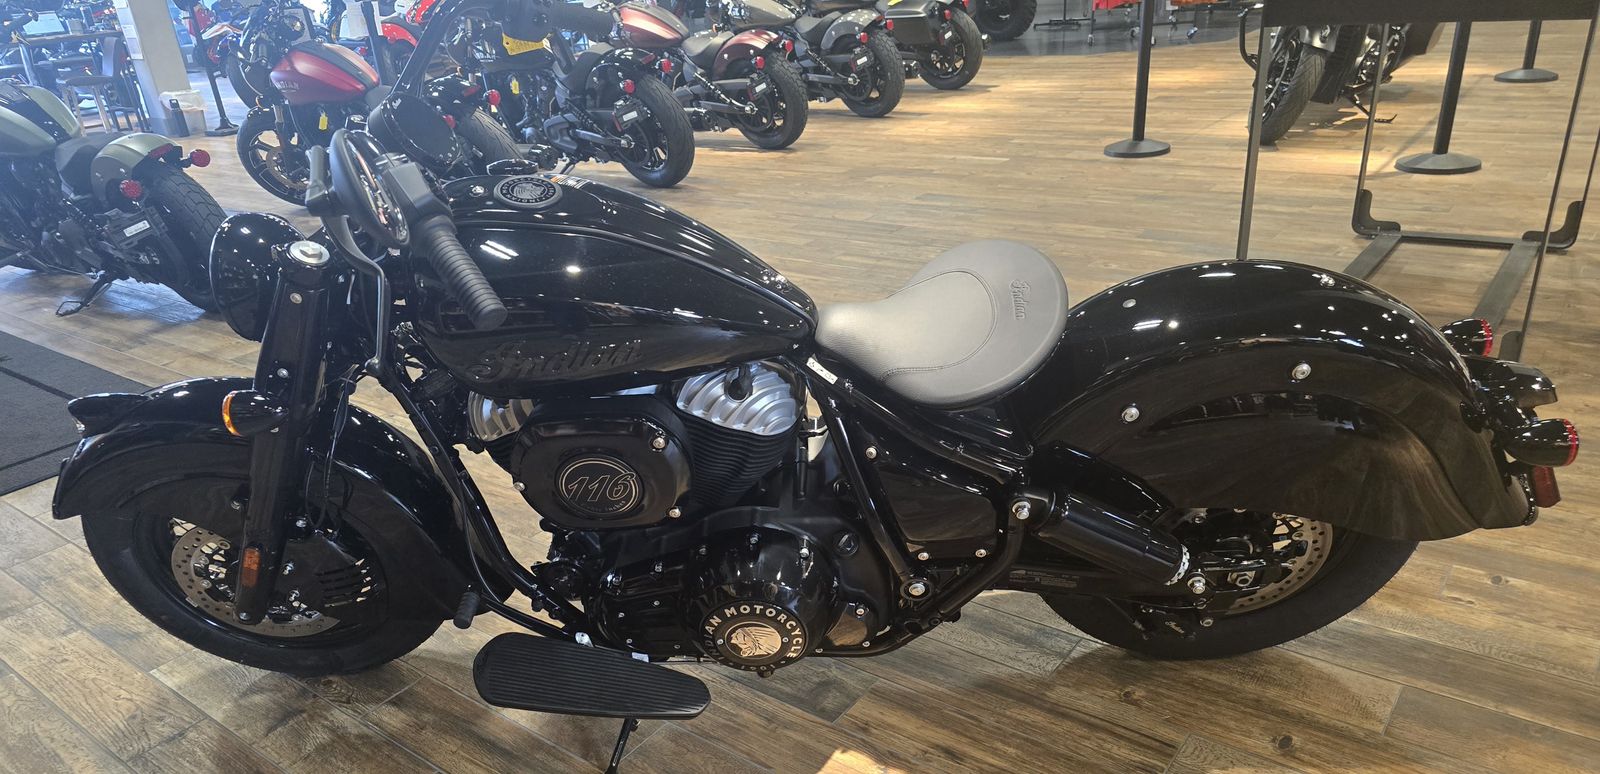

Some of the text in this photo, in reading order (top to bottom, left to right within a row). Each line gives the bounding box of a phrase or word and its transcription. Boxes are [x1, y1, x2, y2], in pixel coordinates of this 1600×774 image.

[1009, 279, 1031, 320] Indian
[466, 340, 642, 384] Indian
[567, 472, 636, 502] 116
[703, 604, 803, 660] INDIAN MOTORCYCLE
